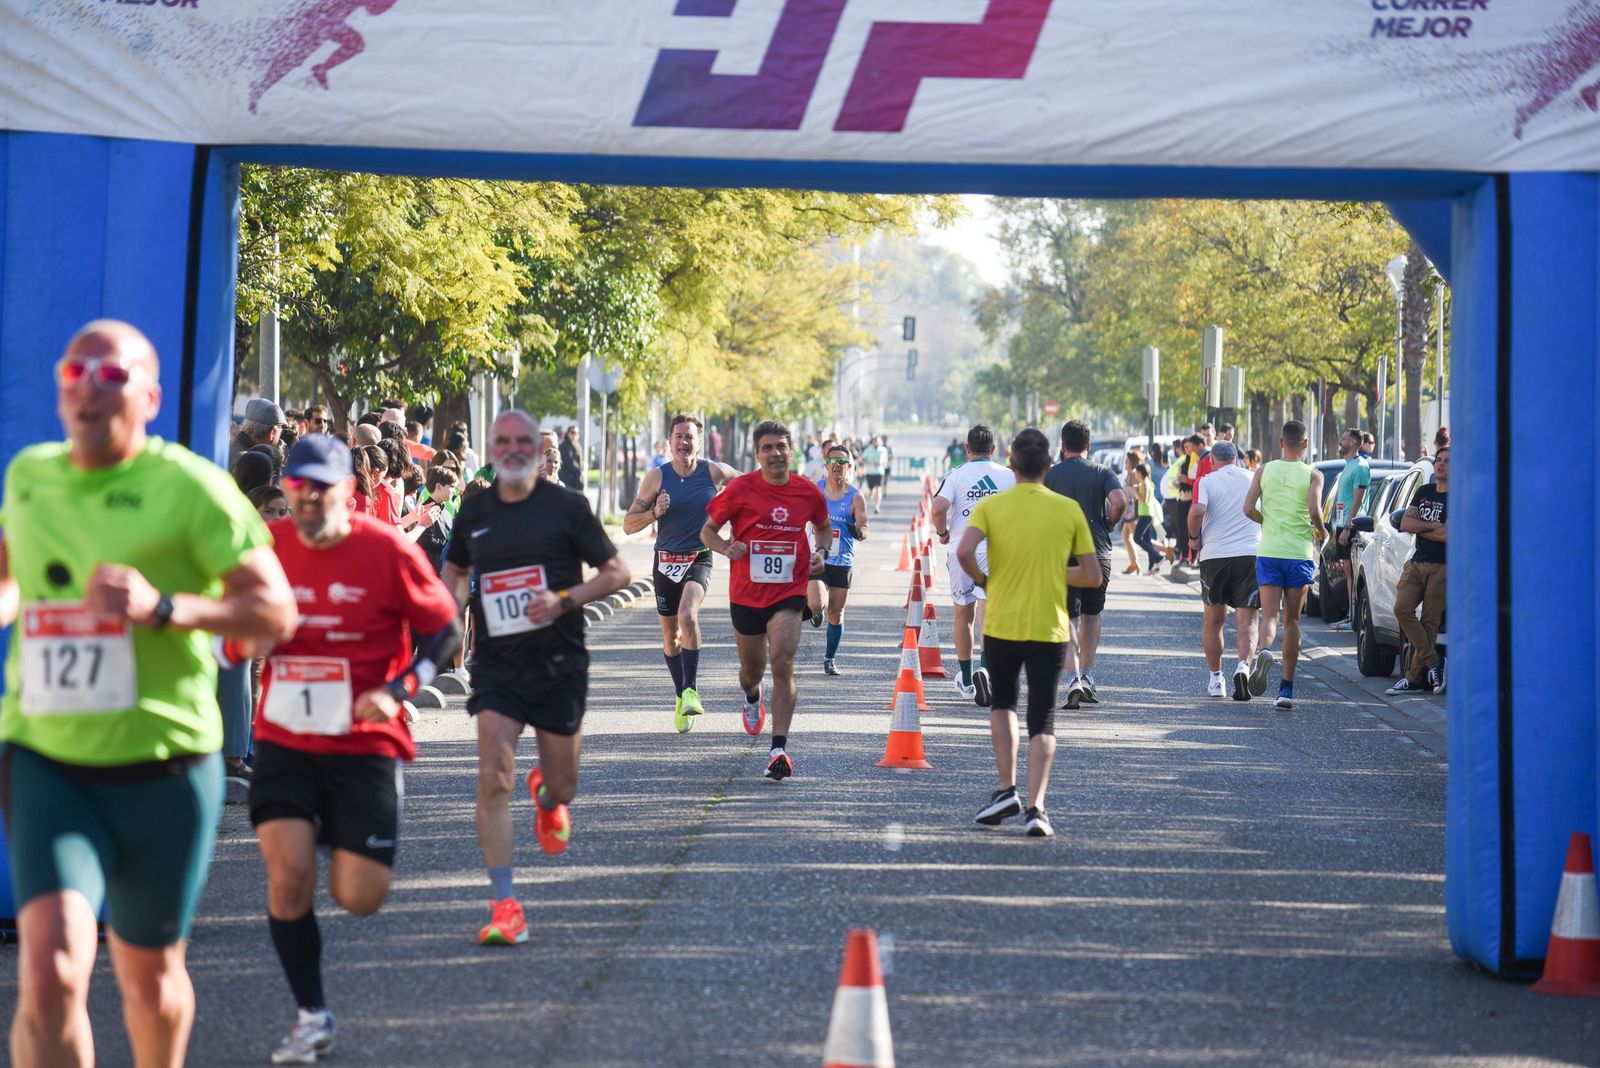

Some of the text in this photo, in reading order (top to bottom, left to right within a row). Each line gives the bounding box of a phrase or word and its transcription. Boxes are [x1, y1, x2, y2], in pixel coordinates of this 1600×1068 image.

[1370, 16, 1472, 38] MEJOR
[665, 564, 689, 577] 227
[763, 556, 783, 575] 89
[41, 644, 105, 689] 127
[301, 687, 311, 717] 1
